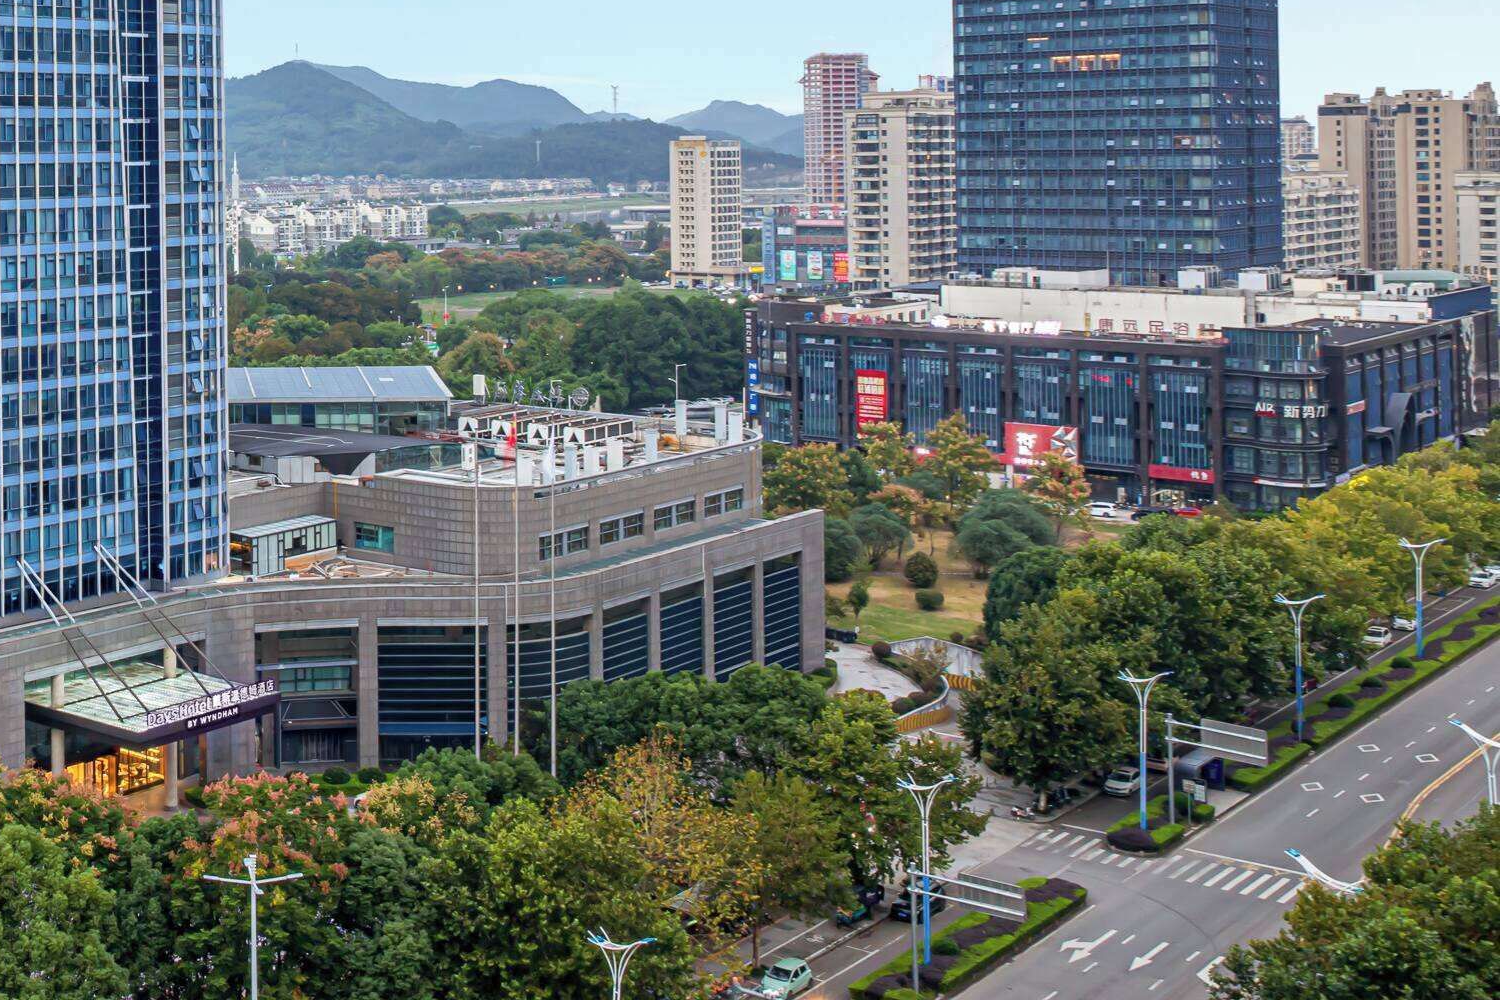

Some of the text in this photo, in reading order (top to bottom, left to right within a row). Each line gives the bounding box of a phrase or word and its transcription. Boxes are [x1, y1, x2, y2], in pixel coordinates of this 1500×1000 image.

[1283, 405, 1326, 419] 新势力
[147, 708, 180, 726] Days
[180, 696, 212, 717] Hotel
[187, 707, 239, 729] BY WYNDHAM
